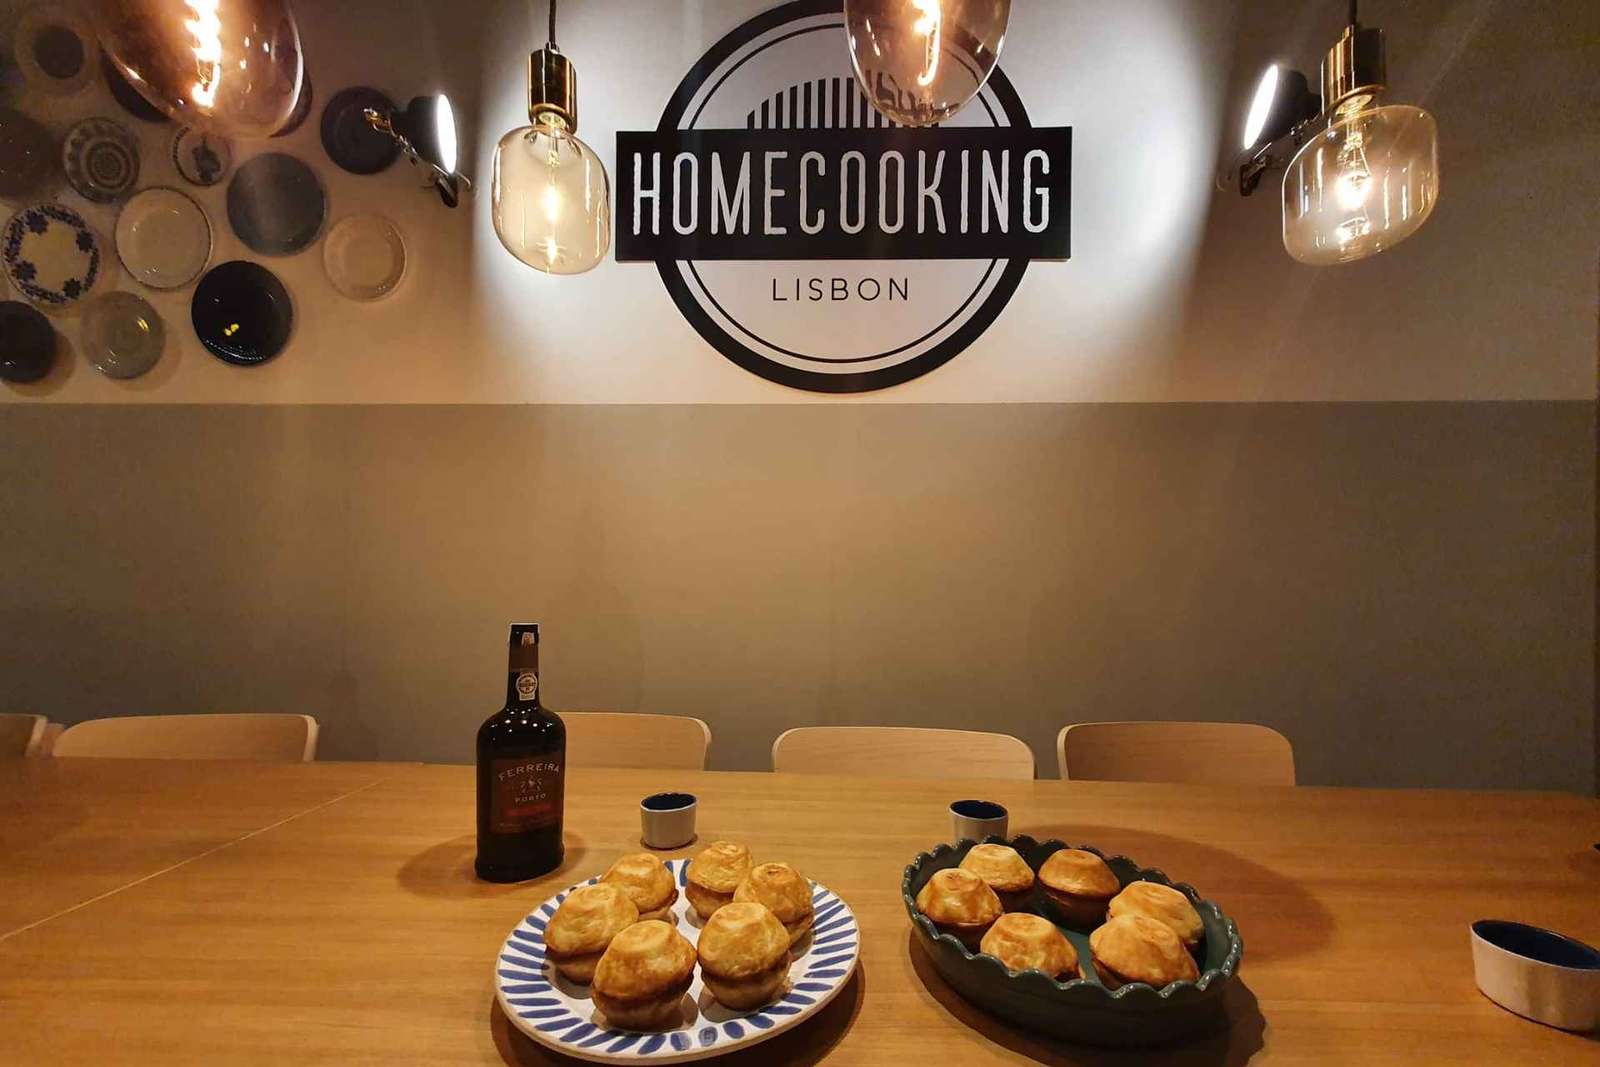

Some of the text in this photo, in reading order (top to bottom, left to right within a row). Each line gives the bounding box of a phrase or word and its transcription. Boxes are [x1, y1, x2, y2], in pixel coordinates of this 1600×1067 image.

[632, 149, 1050, 236] HOMECOOKING
[772, 277, 909, 302] LISBON
[498, 762, 560, 781] FERREIRA
[515, 793, 546, 803] PORTO
